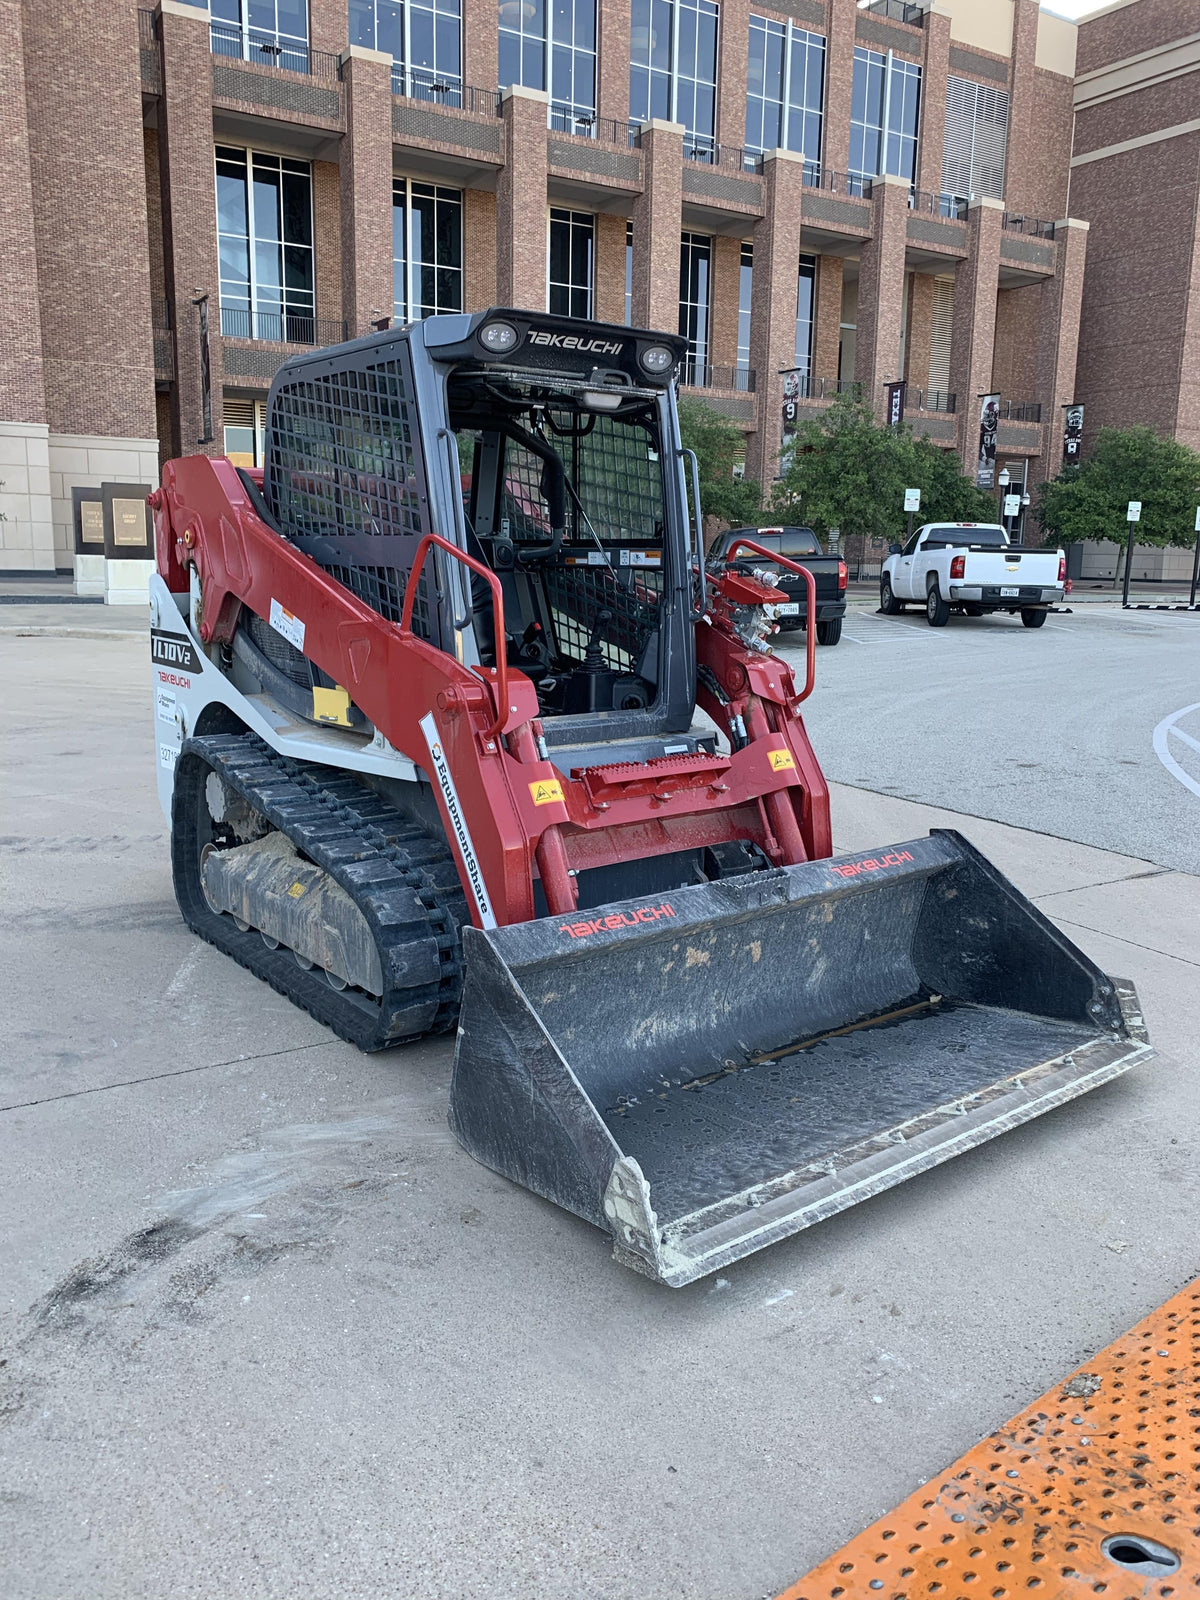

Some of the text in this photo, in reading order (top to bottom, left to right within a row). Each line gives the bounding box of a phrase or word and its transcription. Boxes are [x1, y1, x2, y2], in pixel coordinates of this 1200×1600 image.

[787, 403, 795, 419] 9
[891, 389, 901, 426] TEXA
[158, 671, 191, 689] TAKEUCHI
[437, 759, 488, 914] EquipmentShare
